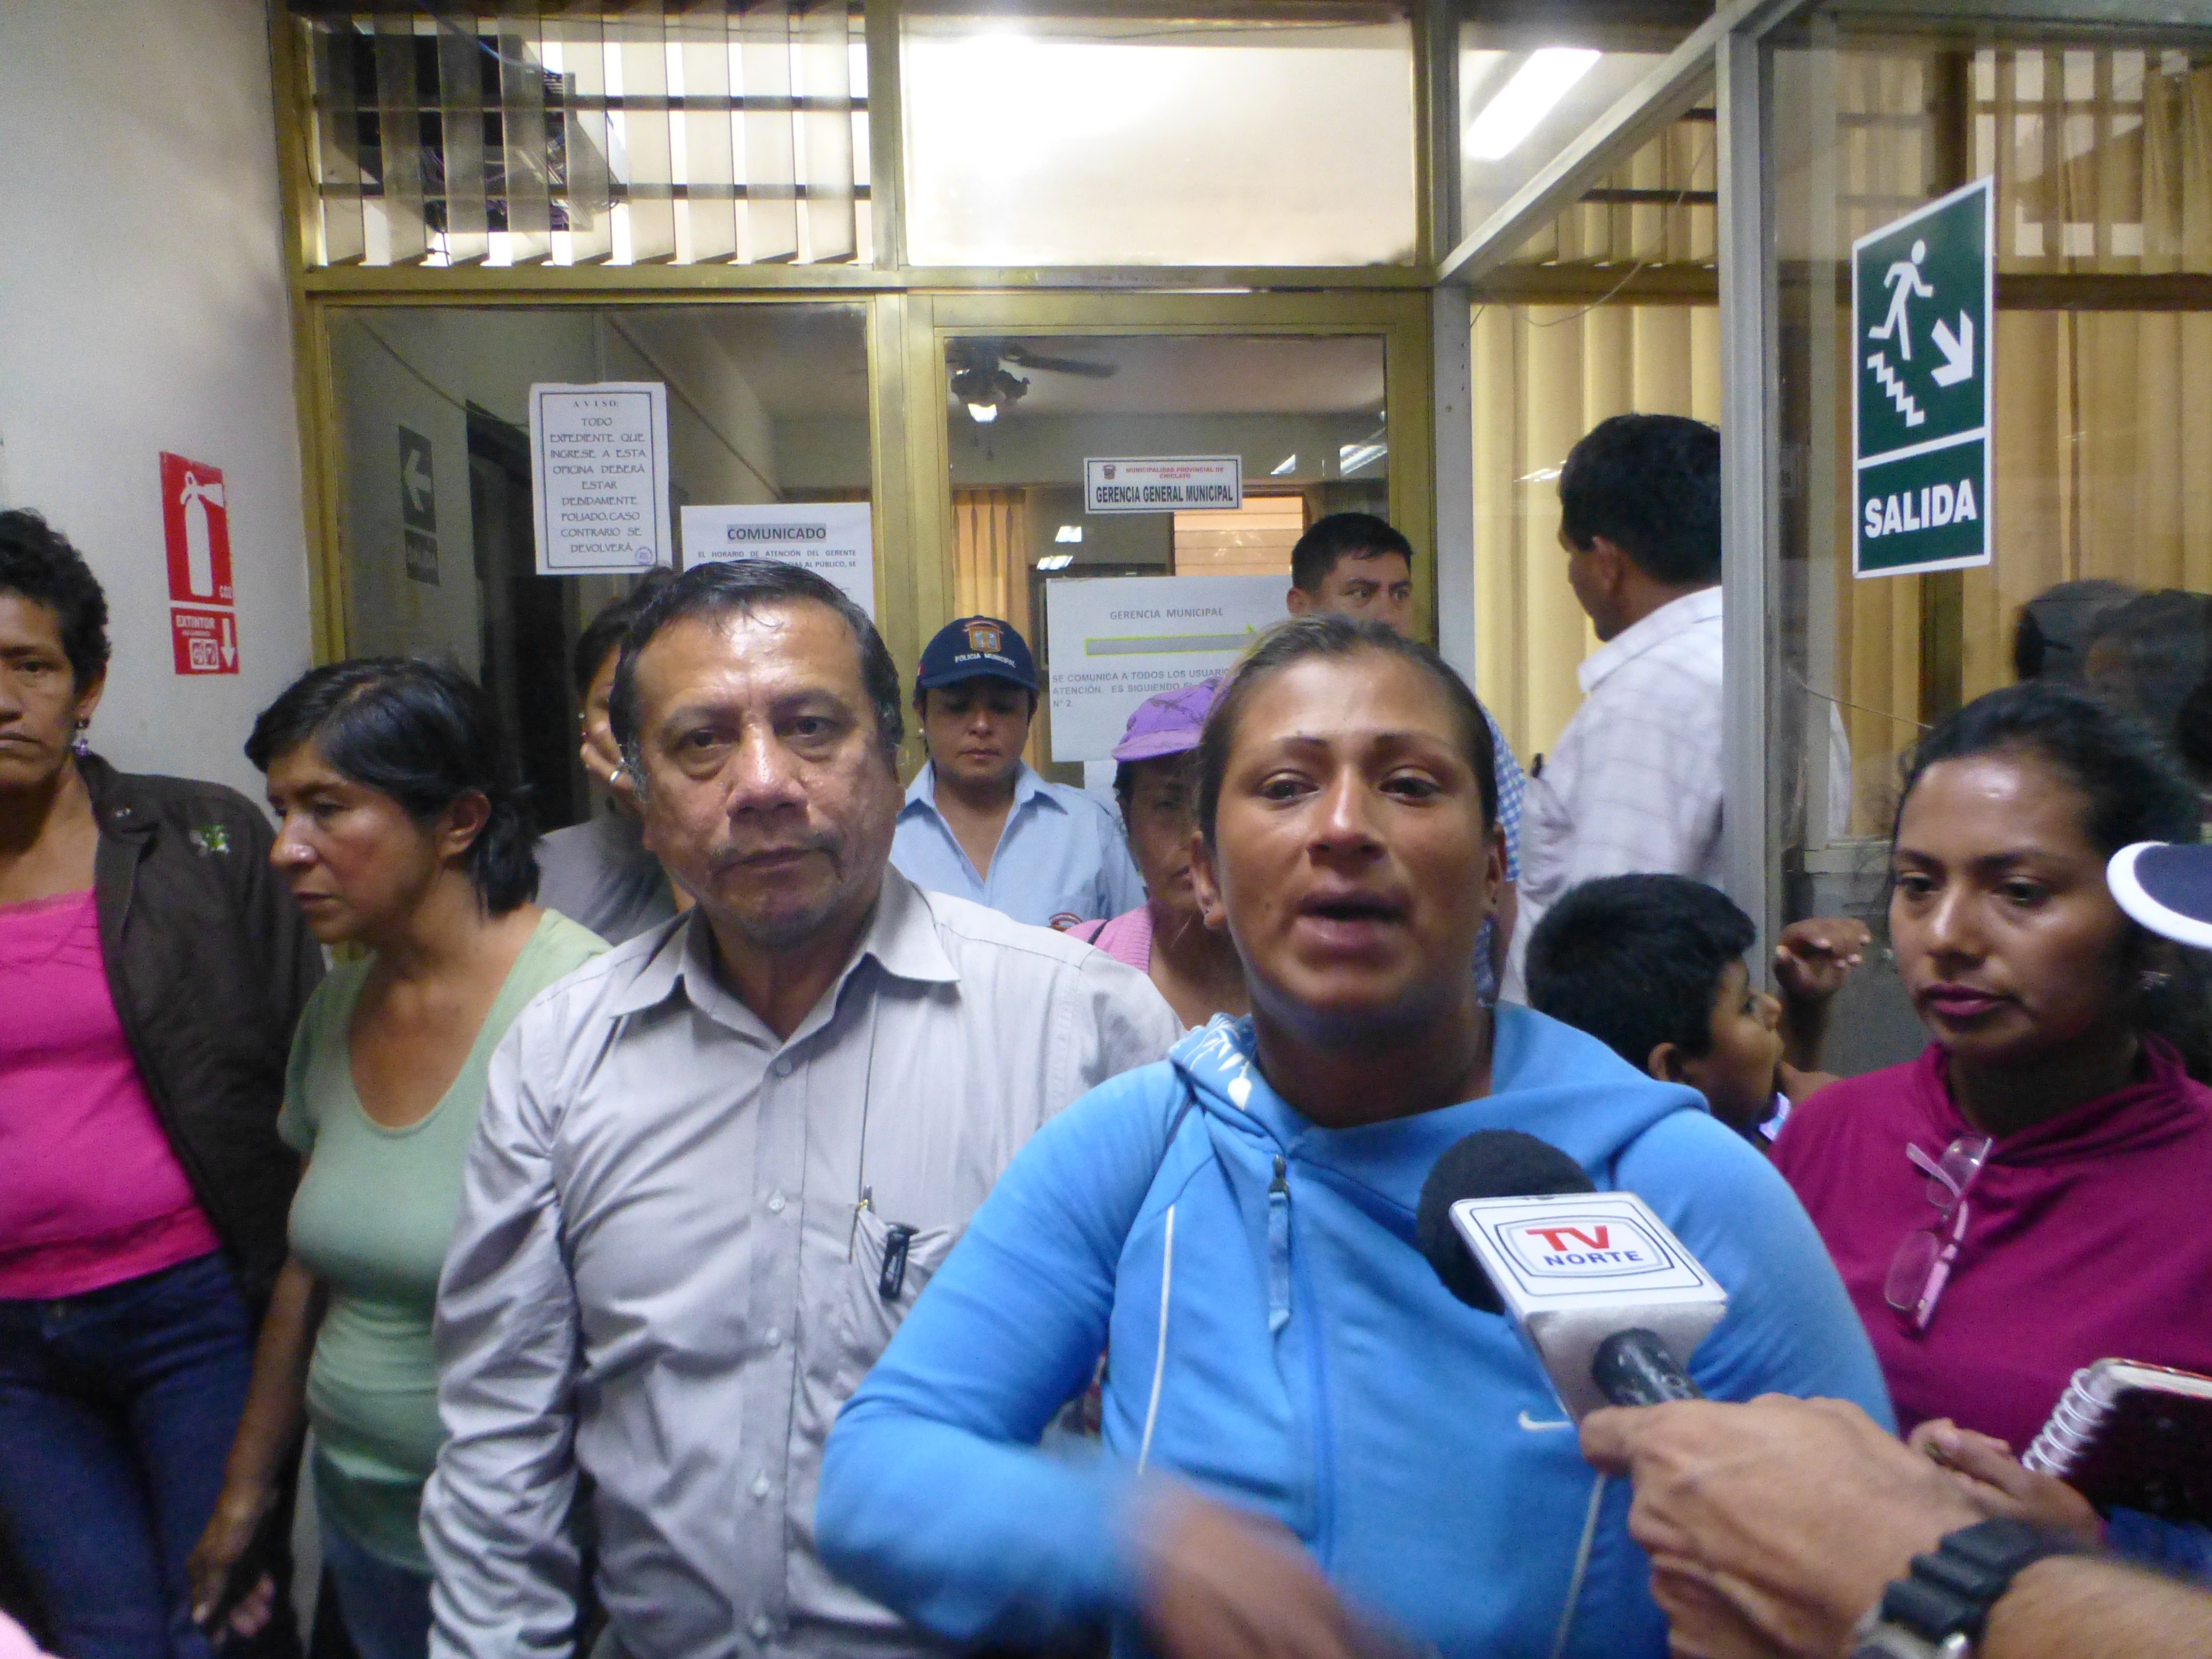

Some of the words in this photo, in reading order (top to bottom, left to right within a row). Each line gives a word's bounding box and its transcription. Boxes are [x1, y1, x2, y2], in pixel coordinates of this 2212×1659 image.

[581, 417, 612, 427] TODO
[550, 434, 615, 442] EXPEDIENTE
[621, 434, 645, 442] QUE
[550, 450, 596, 458] INGRESE
[616, 449, 646, 457] ESTA
[553, 466, 593, 474] OFICINA
[582, 481, 617, 490] ESTAR
[1096, 487, 1141, 503] GERENCIA
[1143, 486, 1183, 502] GENERAL
[1186, 485, 1233, 502] MUNICIPAL
[562, 497, 637, 506] DEBIDAMENTE
[1864, 478, 1977, 538] SALIDA
[561, 528, 621, 537] CONTRARIO
[627, 528, 642, 536] SE
[728, 528, 826, 540] COMUNICADO
[765, 548, 801, 557] ATENCIÓN
[1110, 610, 1161, 620] GERENCIA
[1167, 608, 1223, 618] MUNICIPAL
[1068, 673, 1118, 682] COMUNICA
[1132, 671, 1164, 679] TODOS
[1128, 683, 1180, 692] SIGUIENDO
[1525, 1226, 1609, 1251] TV
[1544, 1251, 1643, 1266] NORTE
